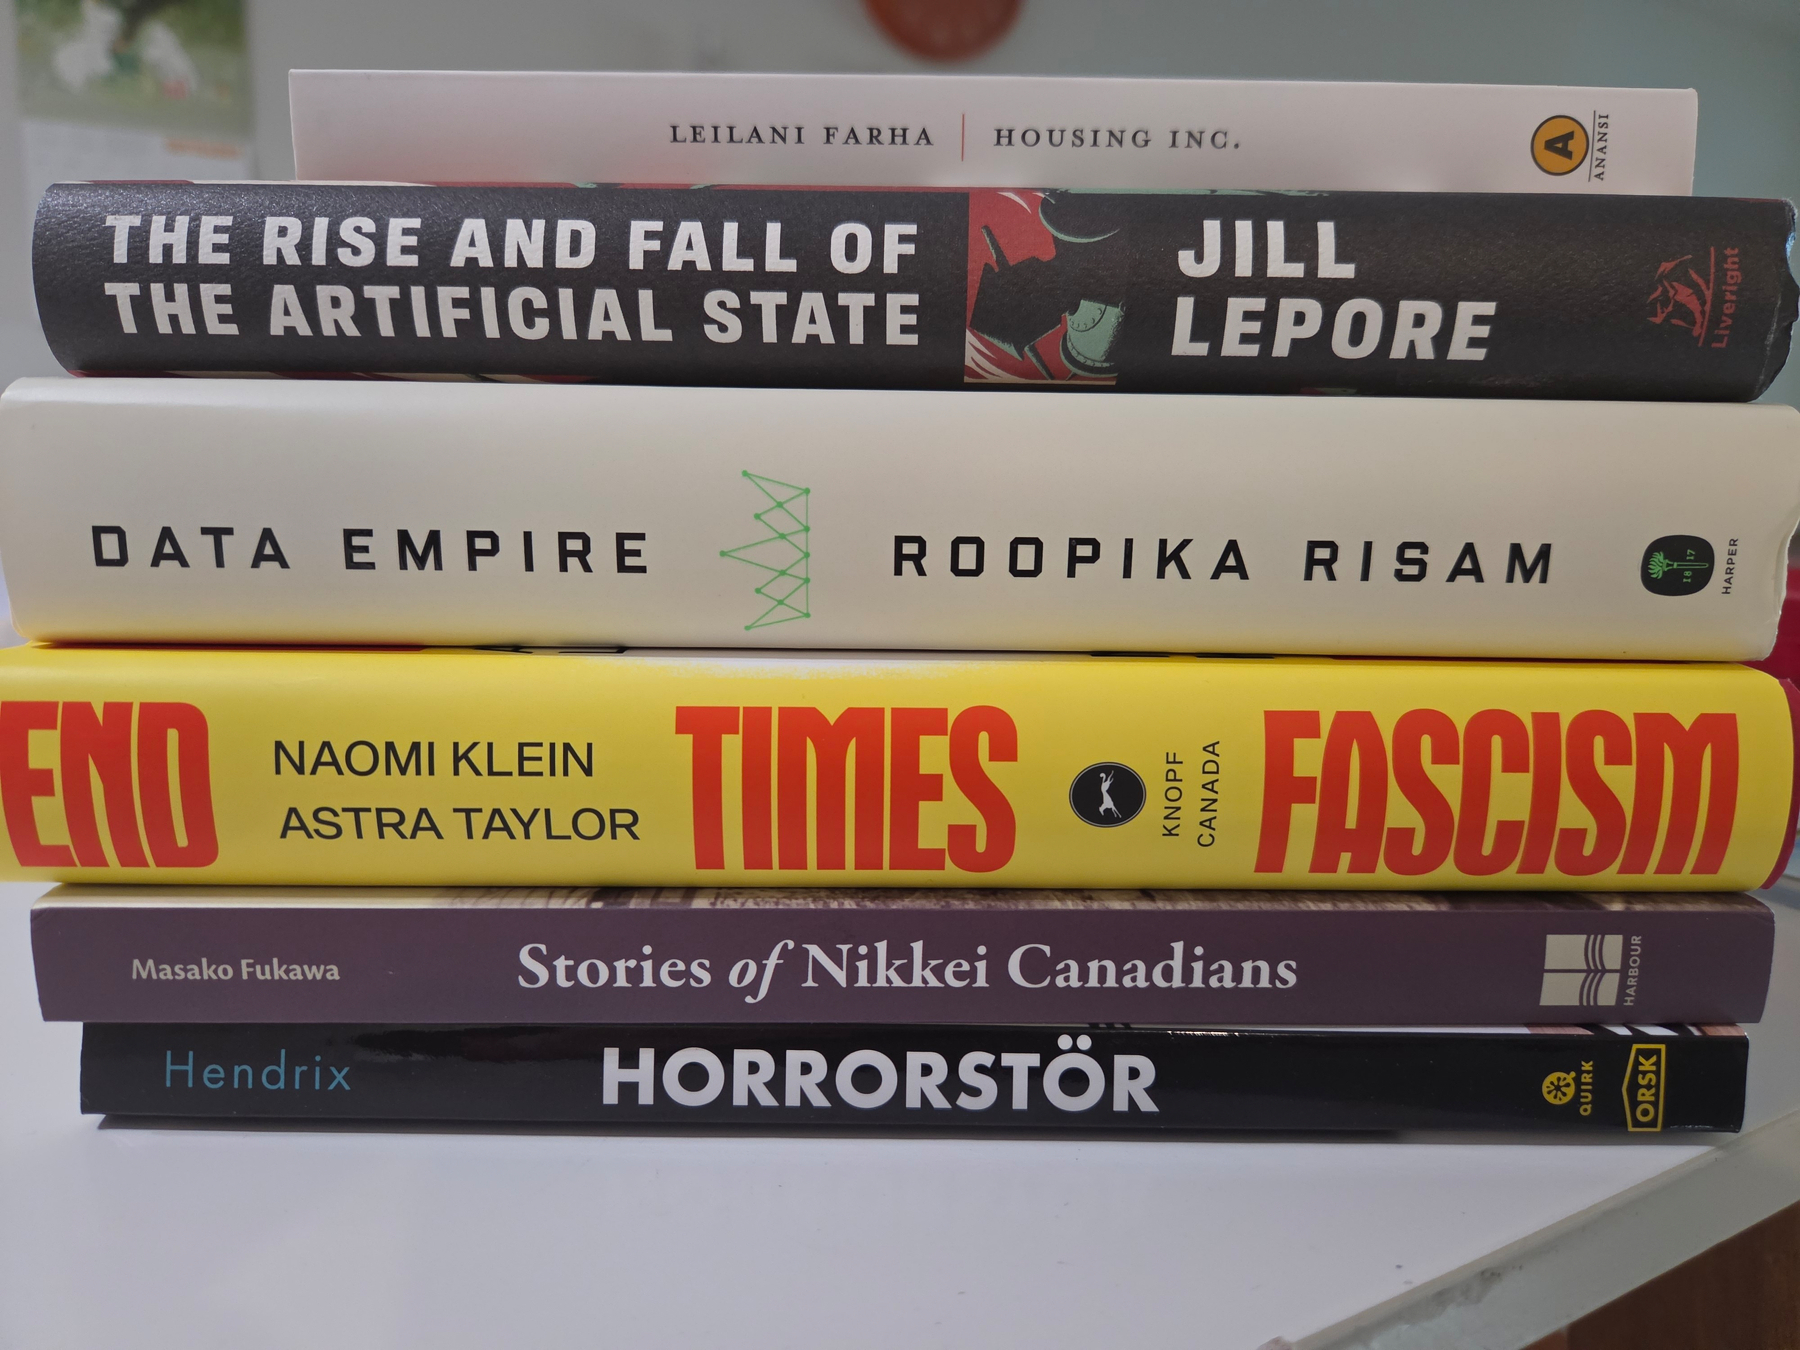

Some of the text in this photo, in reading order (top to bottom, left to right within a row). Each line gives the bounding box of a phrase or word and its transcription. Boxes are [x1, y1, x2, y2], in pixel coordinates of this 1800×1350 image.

[669, 125, 934, 146] LEILANI FARHA
[993, 128, 1240, 150] HOUSING INC.
[1543, 130, 1575, 161] A
[1594, 114, 1609, 181] ANANSI
[104, 214, 918, 275] THE RISE AND FALL OF
[1177, 219, 1356, 279] JILL
[103, 282, 920, 346] THE ARTIFICIAL STATE
[1710, 246, 1744, 348] Liveright
[1171, 296, 1497, 361] LEPORE
[91, 525, 648, 574] DATA EMPIRE
[893, 535, 1552, 584] ROOPIKA RISAM
[1721, 538, 1739, 595] HARPER
[0, 700, 219, 868] END
[274, 740, 593, 778] NAOMI KLEIN
[674, 705, 1018, 874] TIMES
[279, 806, 641, 841] ASTRA TAYLOR
[1161, 751, 1184, 837] KNOPF
[1196, 740, 1220, 848] CANADA
[1253, 708, 1740, 877] FASCISM
[131, 957, 341, 981] Masako Fukawa
[518, 939, 1297, 1004] Stories of Nikkei Canadians
[1621, 934, 1642, 1006] HARBOUR
[165, 1048, 351, 1091] Hendrix
[602, 1034, 1160, 1112] HORRORSTÖR
[1579, 1060, 1594, 1116] QUIRK
[1635, 1054, 1657, 1122] ORSK
